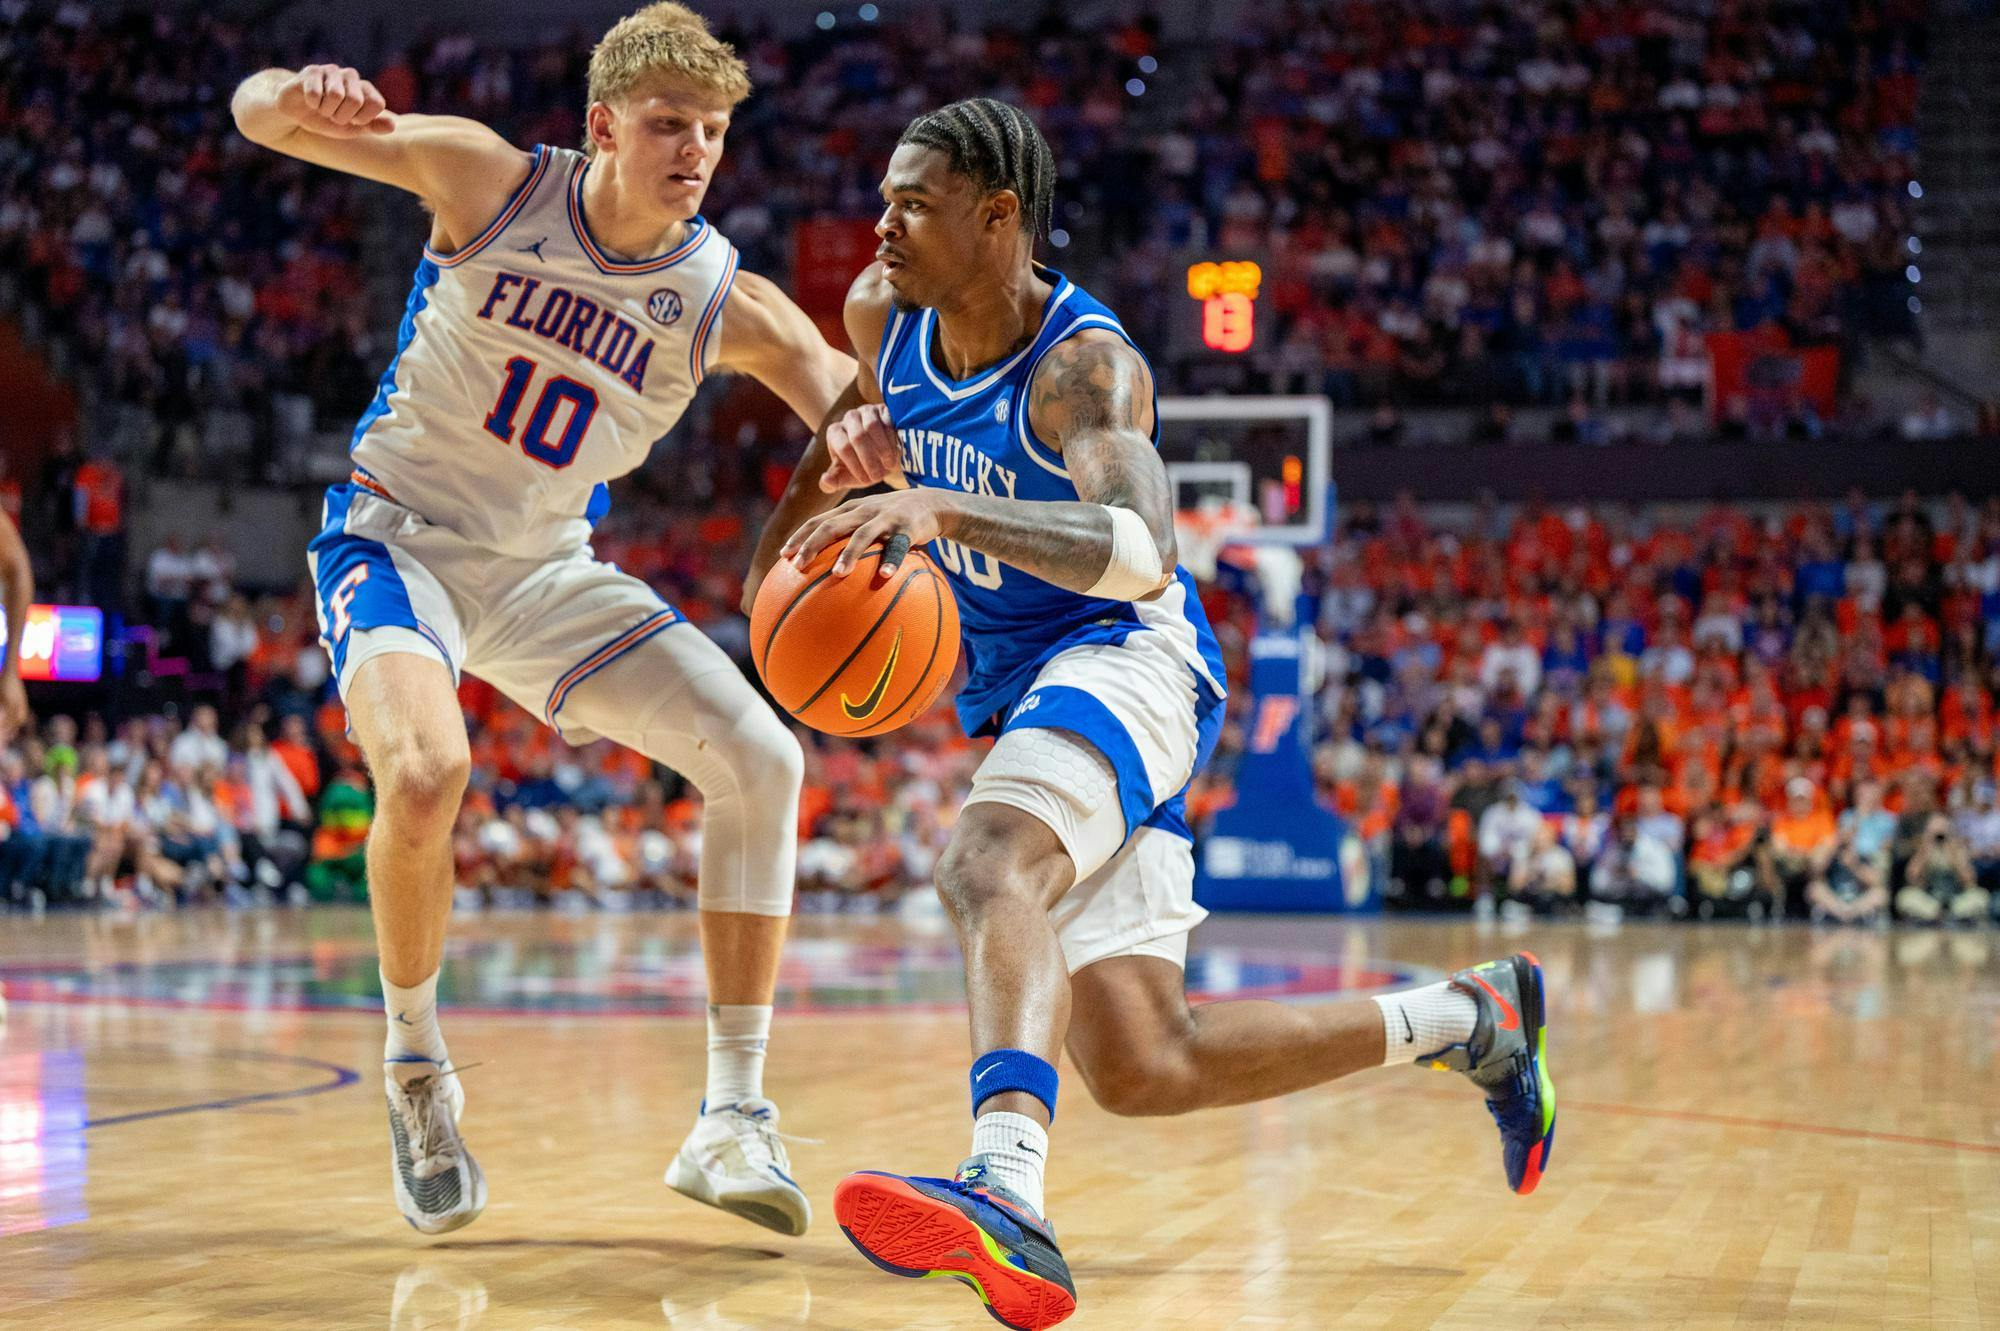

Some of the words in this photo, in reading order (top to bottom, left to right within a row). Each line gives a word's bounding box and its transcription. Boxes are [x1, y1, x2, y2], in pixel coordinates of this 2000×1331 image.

[477, 272, 655, 395] FLORIDA
[647, 288, 682, 325] SEC
[483, 355, 600, 470] 10
[897, 428, 1017, 500] ENTUCKY
[330, 562, 369, 642] F
